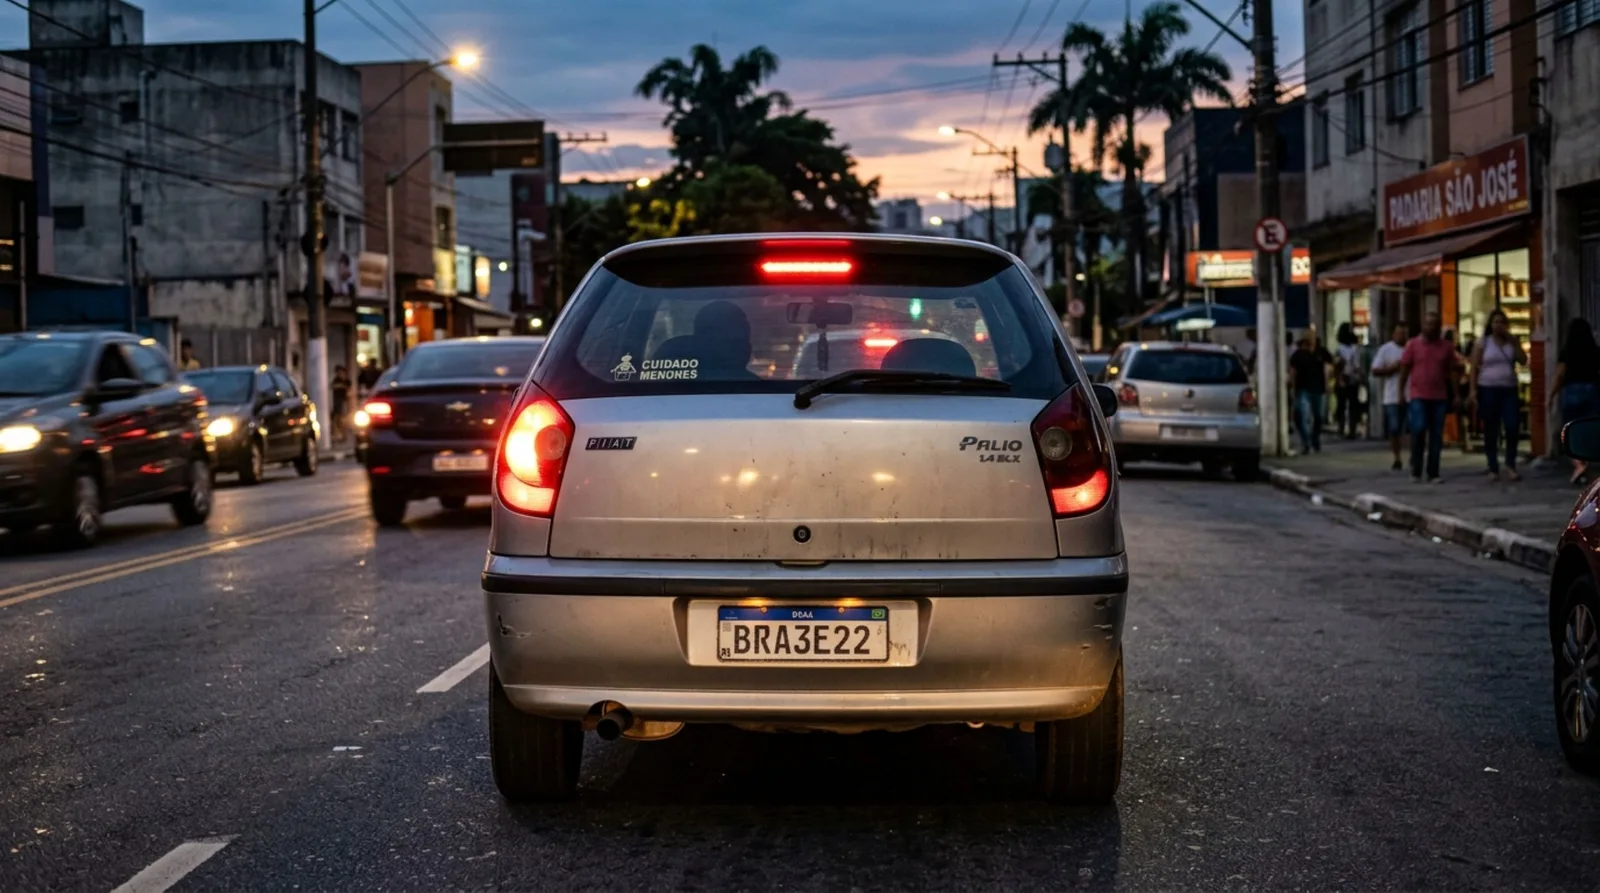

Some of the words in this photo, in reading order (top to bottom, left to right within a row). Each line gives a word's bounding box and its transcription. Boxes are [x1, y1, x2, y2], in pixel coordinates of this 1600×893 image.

[1389, 184, 1442, 231] PADARIA
[1477, 149, 1518, 208] JOSÉ
[641, 359, 698, 370] CUIDADO
[959, 436, 1023, 452] PALIO
[733, 625, 870, 655] BRA3E22
